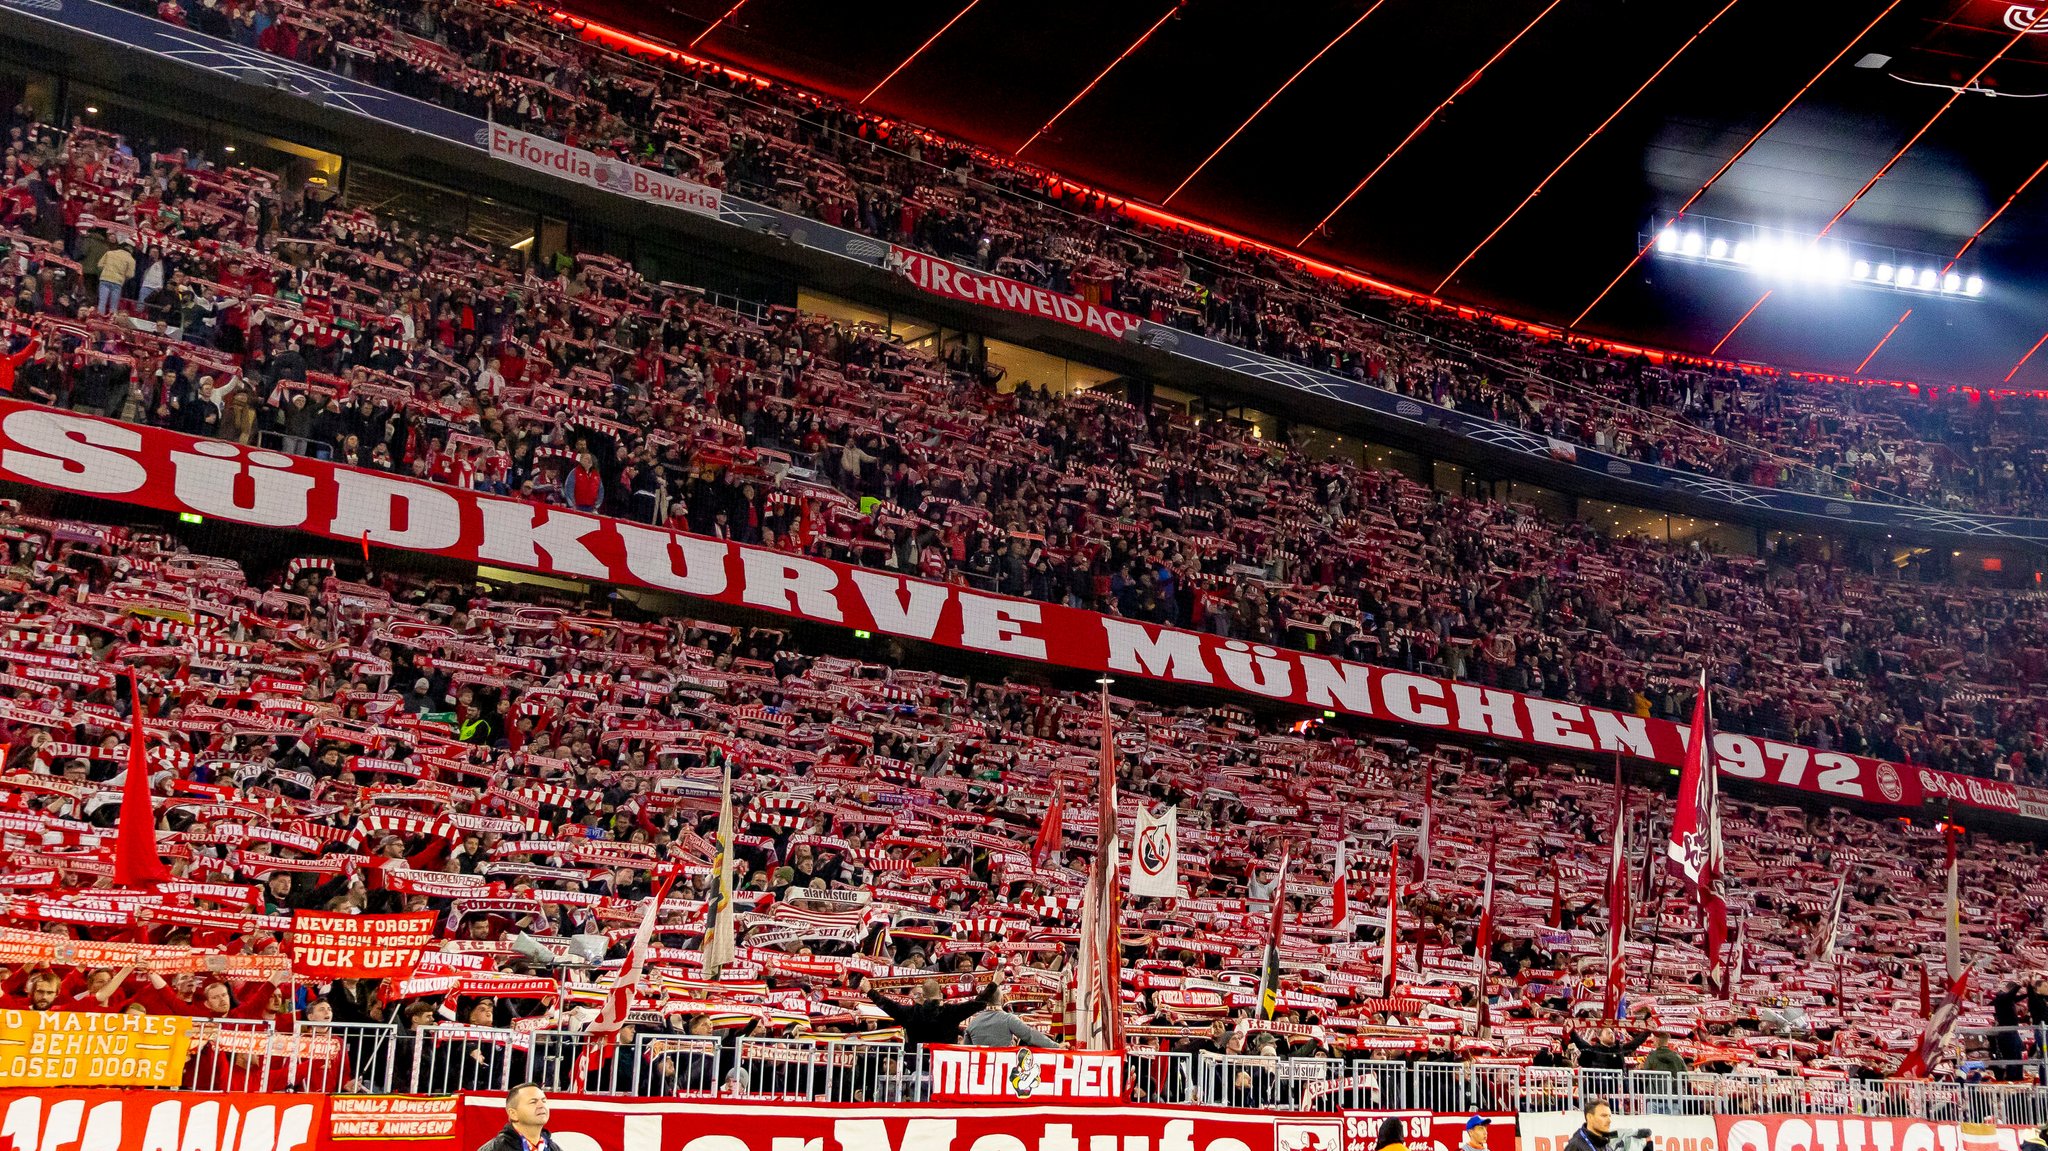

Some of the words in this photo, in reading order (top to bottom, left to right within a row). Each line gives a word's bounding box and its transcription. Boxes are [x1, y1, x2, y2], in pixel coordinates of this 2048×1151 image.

[493, 128, 591, 179] Erfordia
[633, 171, 720, 211] Bavaria
[2, 409, 1048, 660] SÜDKURVE
[1099, 616, 1657, 760] MÜNCHEN
[27, 667, 100, 685] SÜDKURVE
[358, 758, 422, 776] SÜDKURVE
[947, 814, 985, 823] BAYERN
[29, 857, 68, 868] BAYERN
[258, 853, 295, 864] BAYERN
[156, 882, 249, 899] SÜDKURVE
[412, 884, 490, 898] SÜDKURVE
[534, 889, 600, 907] SÜDKURVE
[736, 891, 754, 899] MIA
[38, 905, 128, 924] SÜDKURVE
[296, 916, 358, 932] NEVER
[819, 929, 839, 937] SEIT
[293, 946, 355, 967] FUCK
[364, 949, 421, 968] UEFA
[463, 980, 550, 989] SEENLANDFRONT
[39, 1010, 177, 1036] MATCHES
[1249, 1019, 1268, 1030] F.C.
[1270, 1020, 1313, 1035] BAYERN
[30, 1033, 129, 1055] BEHIND
[88, 1057, 169, 1081] DOORS
[333, 1099, 388, 1112] NIEMALS
[390, 1099, 457, 1113] ABWESEND
[333, 1121, 379, 1135] IMMER
[1410, 1116, 1431, 1138] SV
